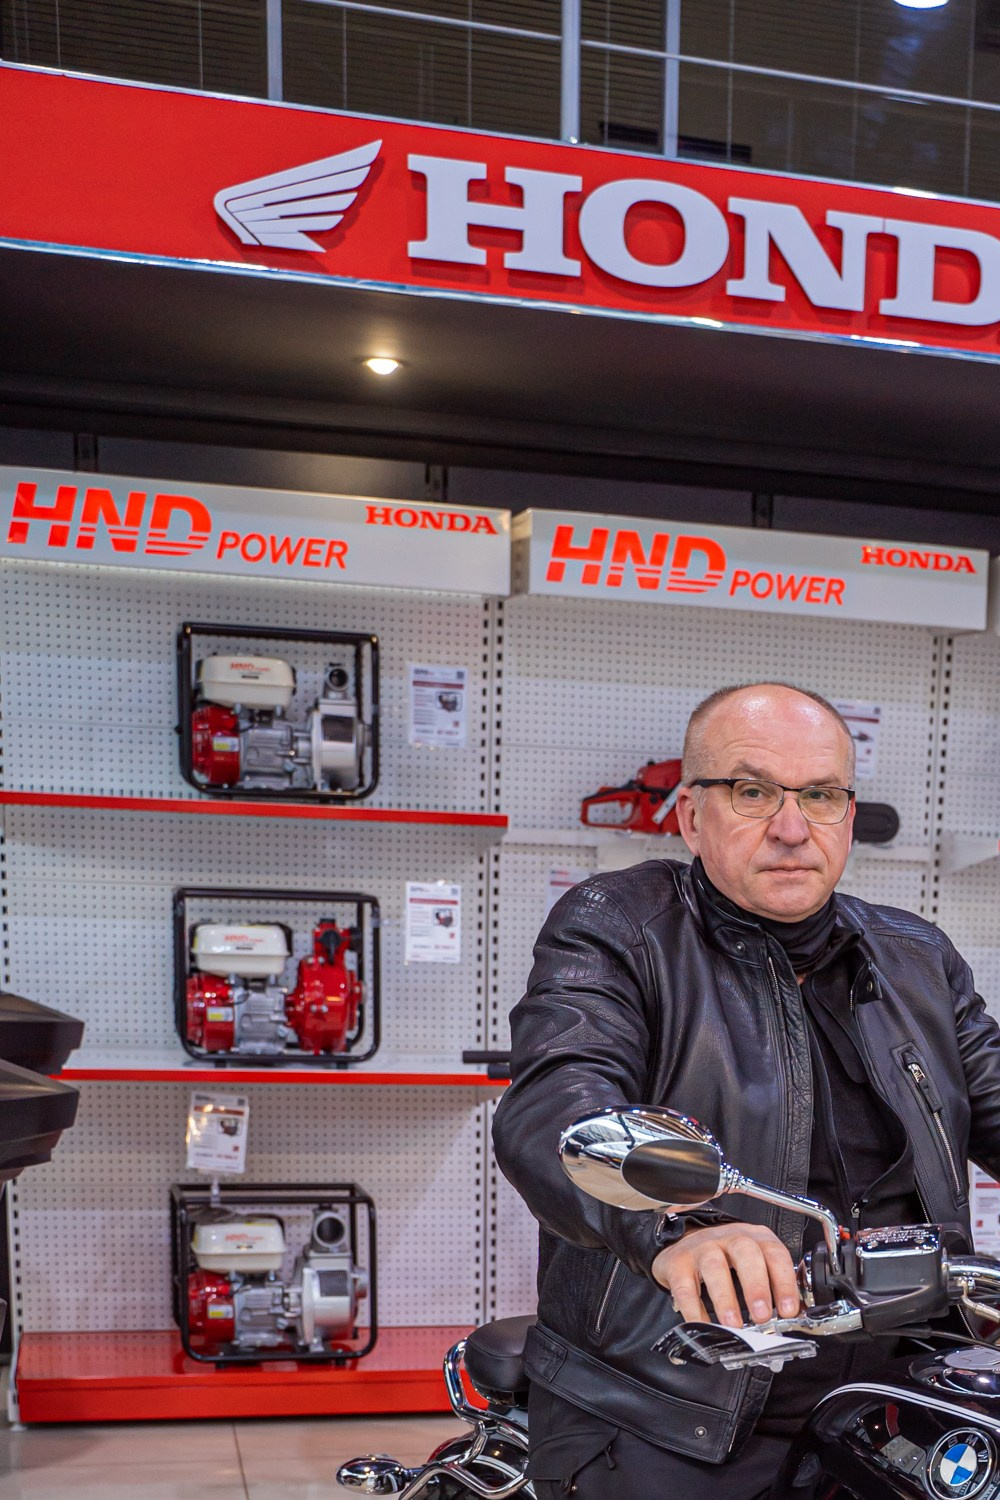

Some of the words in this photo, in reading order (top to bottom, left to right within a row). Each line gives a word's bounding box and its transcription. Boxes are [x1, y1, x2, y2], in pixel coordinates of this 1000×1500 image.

[7, 481, 212, 557] HND
[216, 530, 349, 570] POWER
[365, 505, 498, 536] HONDA
[545, 525, 727, 594] HND
[729, 569, 847, 606] POWER
[860, 545, 977, 575] HONDA
[947, 1434, 989, 1463] BMW
